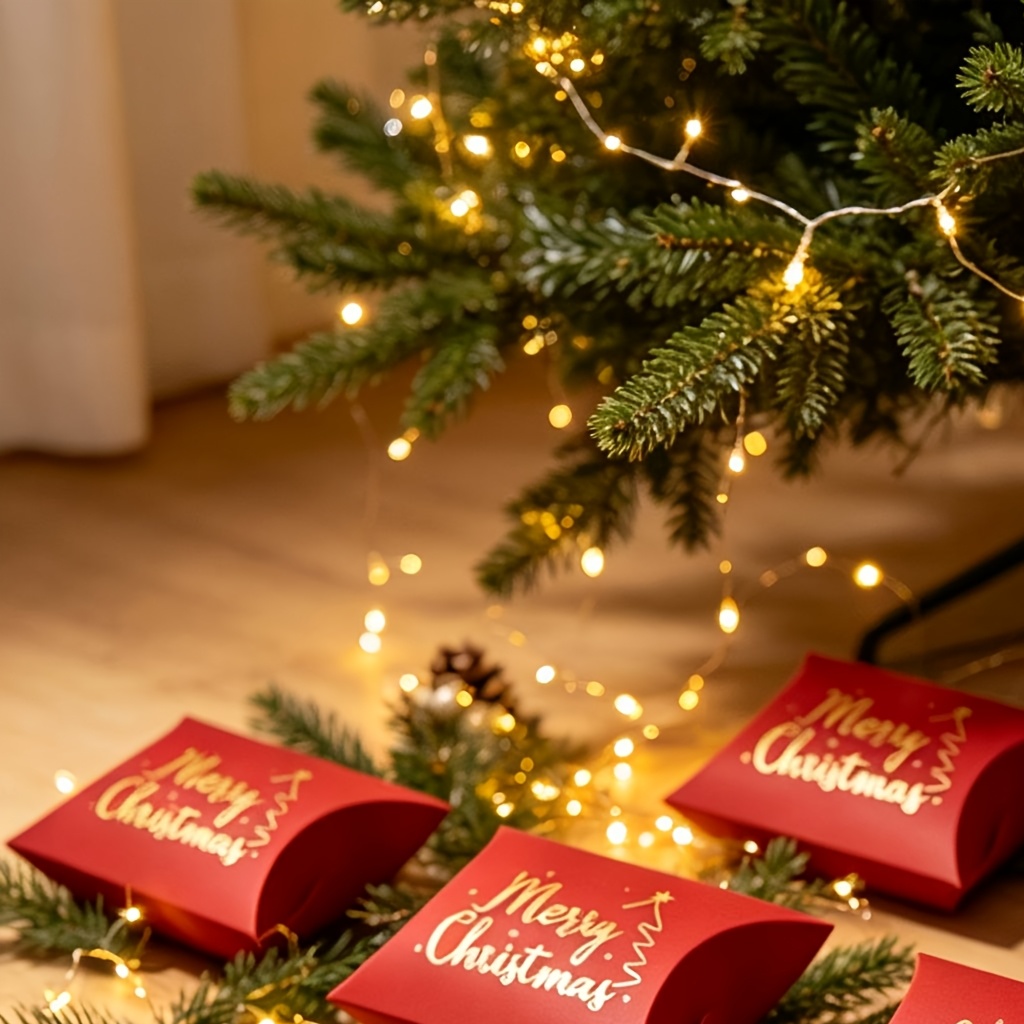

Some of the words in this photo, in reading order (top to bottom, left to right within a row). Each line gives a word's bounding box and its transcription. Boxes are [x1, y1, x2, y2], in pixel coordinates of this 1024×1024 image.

[753, 721, 930, 815] Christmas
[794, 688, 931, 773] Merry
[95, 775, 248, 866] Christmas
[425, 909, 616, 1011] Christmas
[471, 871, 624, 966] Merry
